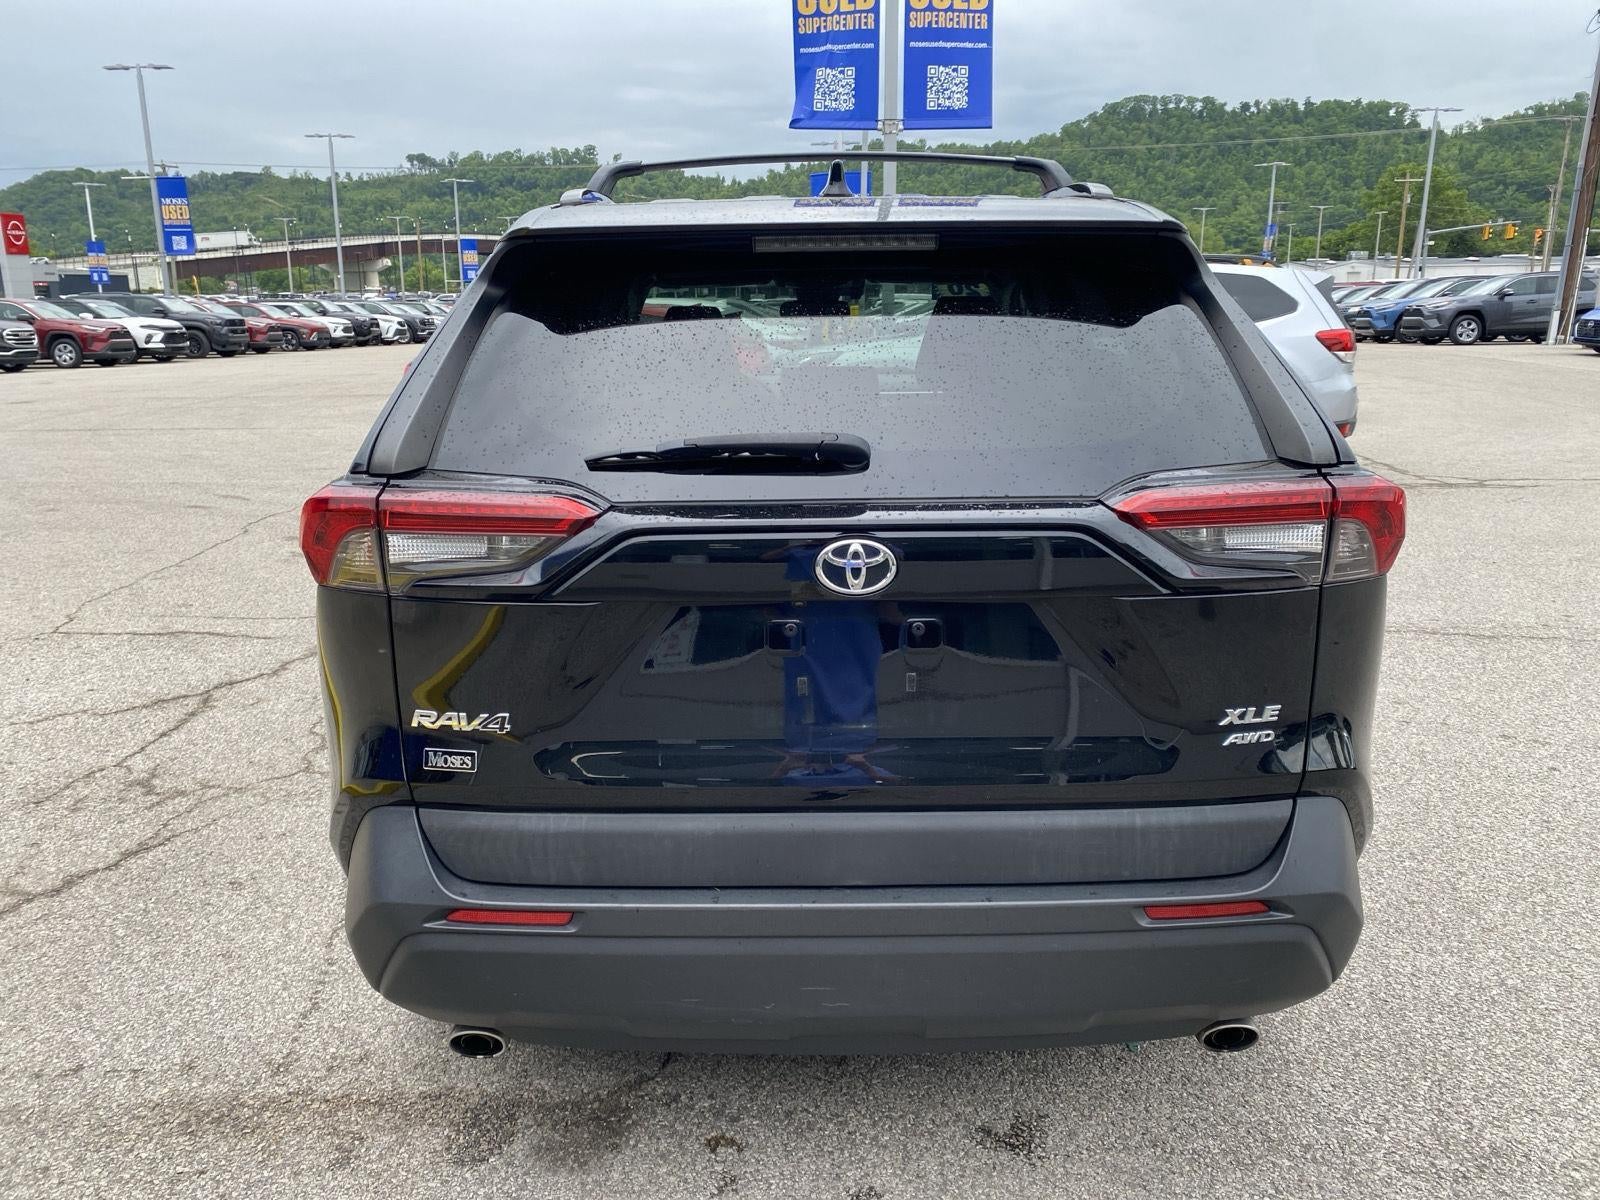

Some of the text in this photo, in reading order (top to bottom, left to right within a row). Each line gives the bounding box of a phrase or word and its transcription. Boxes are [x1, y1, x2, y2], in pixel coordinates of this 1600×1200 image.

[798, 13, 875, 34] SUPERCENTER
[909, 11, 988, 29] SUPERCENTER
[909, 40, 988, 48] mosesusedsupercenter.com
[160, 197, 188, 205] MOSES
[161, 205, 190, 220] USED
[411, 709, 511, 734] RAV4
[1218, 705, 1282, 725] XLE
[1222, 730, 1275, 746] AWD
